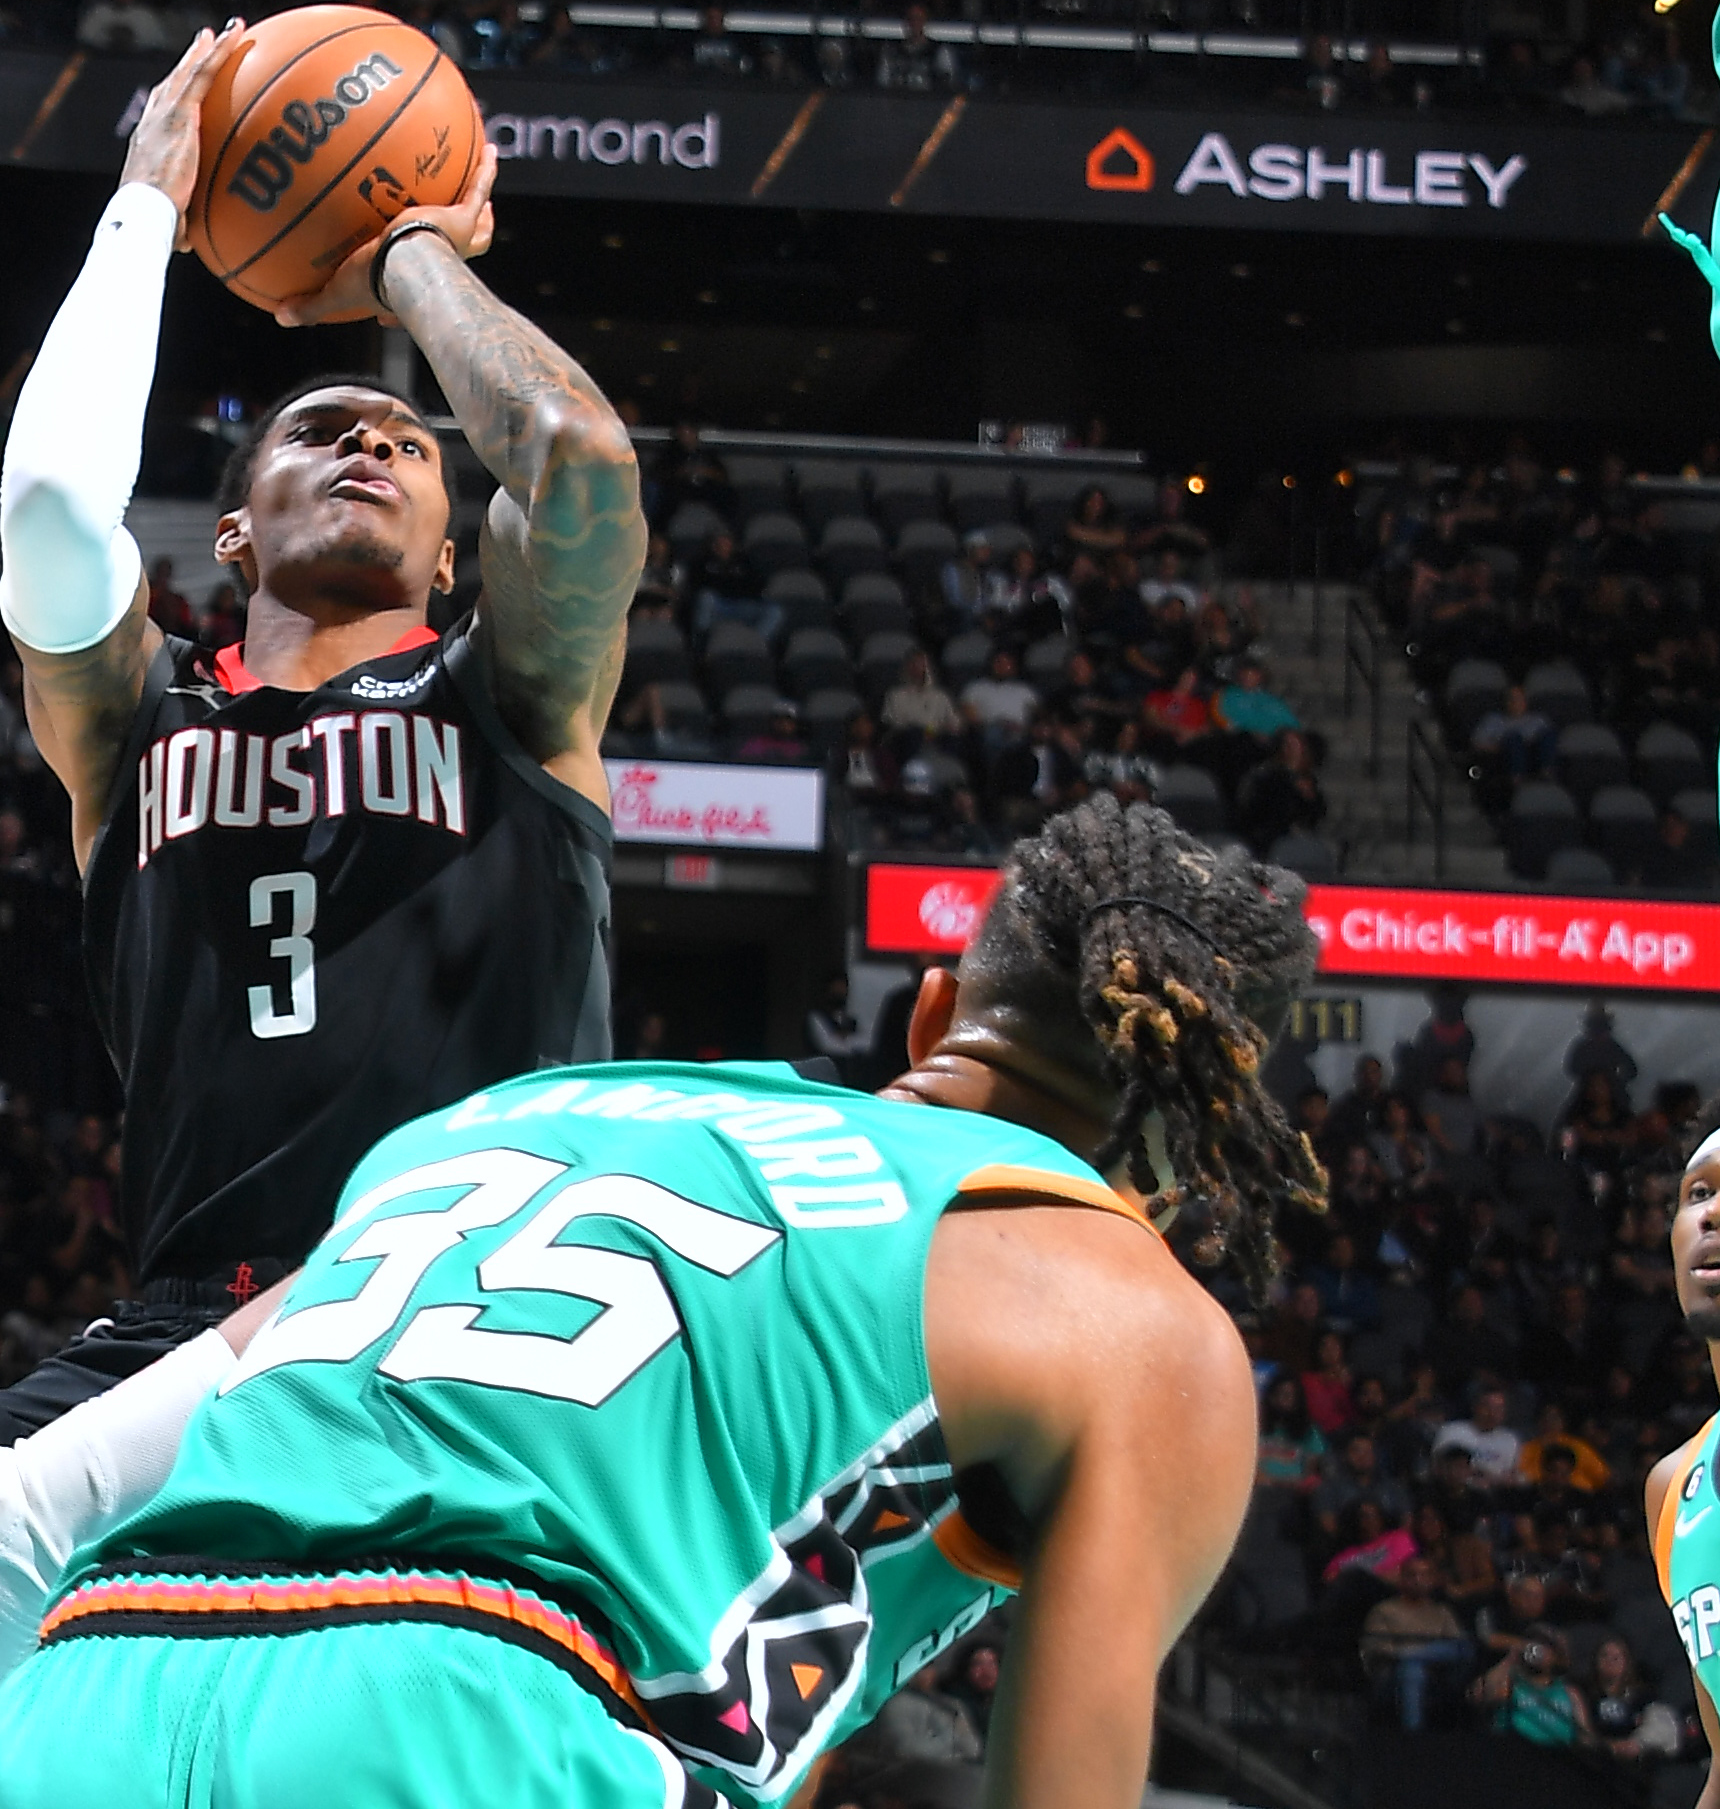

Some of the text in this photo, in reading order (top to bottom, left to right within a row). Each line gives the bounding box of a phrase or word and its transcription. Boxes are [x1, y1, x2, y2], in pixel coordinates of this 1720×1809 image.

[226, 50, 404, 214] Wilson
[482, 110, 721, 170] amond
[1174, 132, 1528, 208] ASHLEY
[137, 708, 467, 873] HOUSTON
[247, 871, 318, 1040] 3
[1340, 908, 1592, 962] Chick-fil-A
[1600, 919, 1693, 974] App
[212, 1147, 785, 1410] 35
